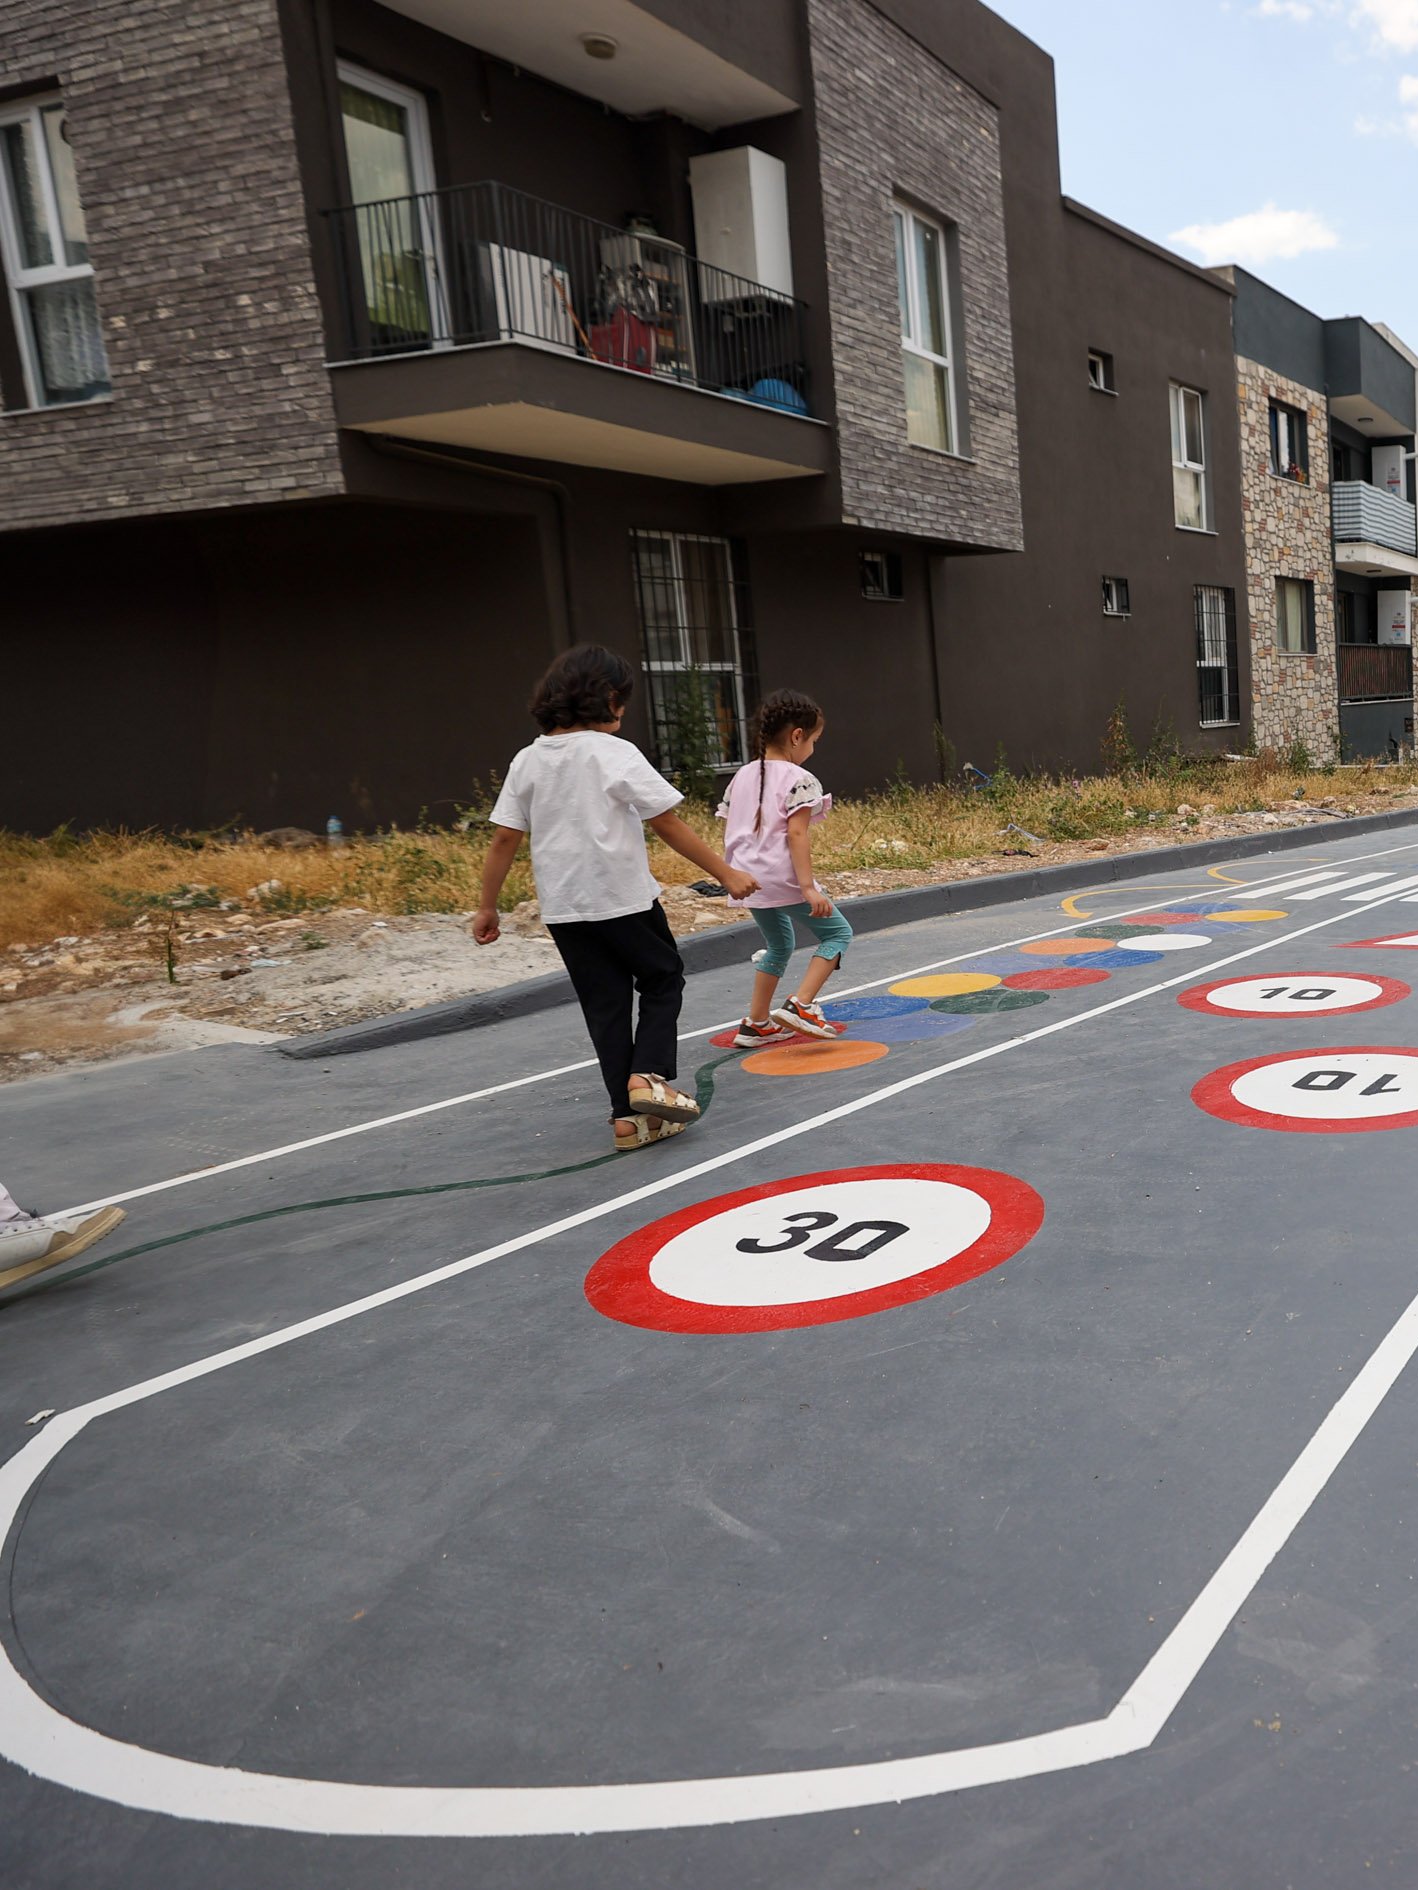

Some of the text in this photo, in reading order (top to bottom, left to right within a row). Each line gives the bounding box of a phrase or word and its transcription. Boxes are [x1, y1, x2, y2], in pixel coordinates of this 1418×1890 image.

[1259, 986, 1336, 1000] 10
[1292, 1070, 1401, 1096] 10
[735, 1211, 910, 1262] 30
